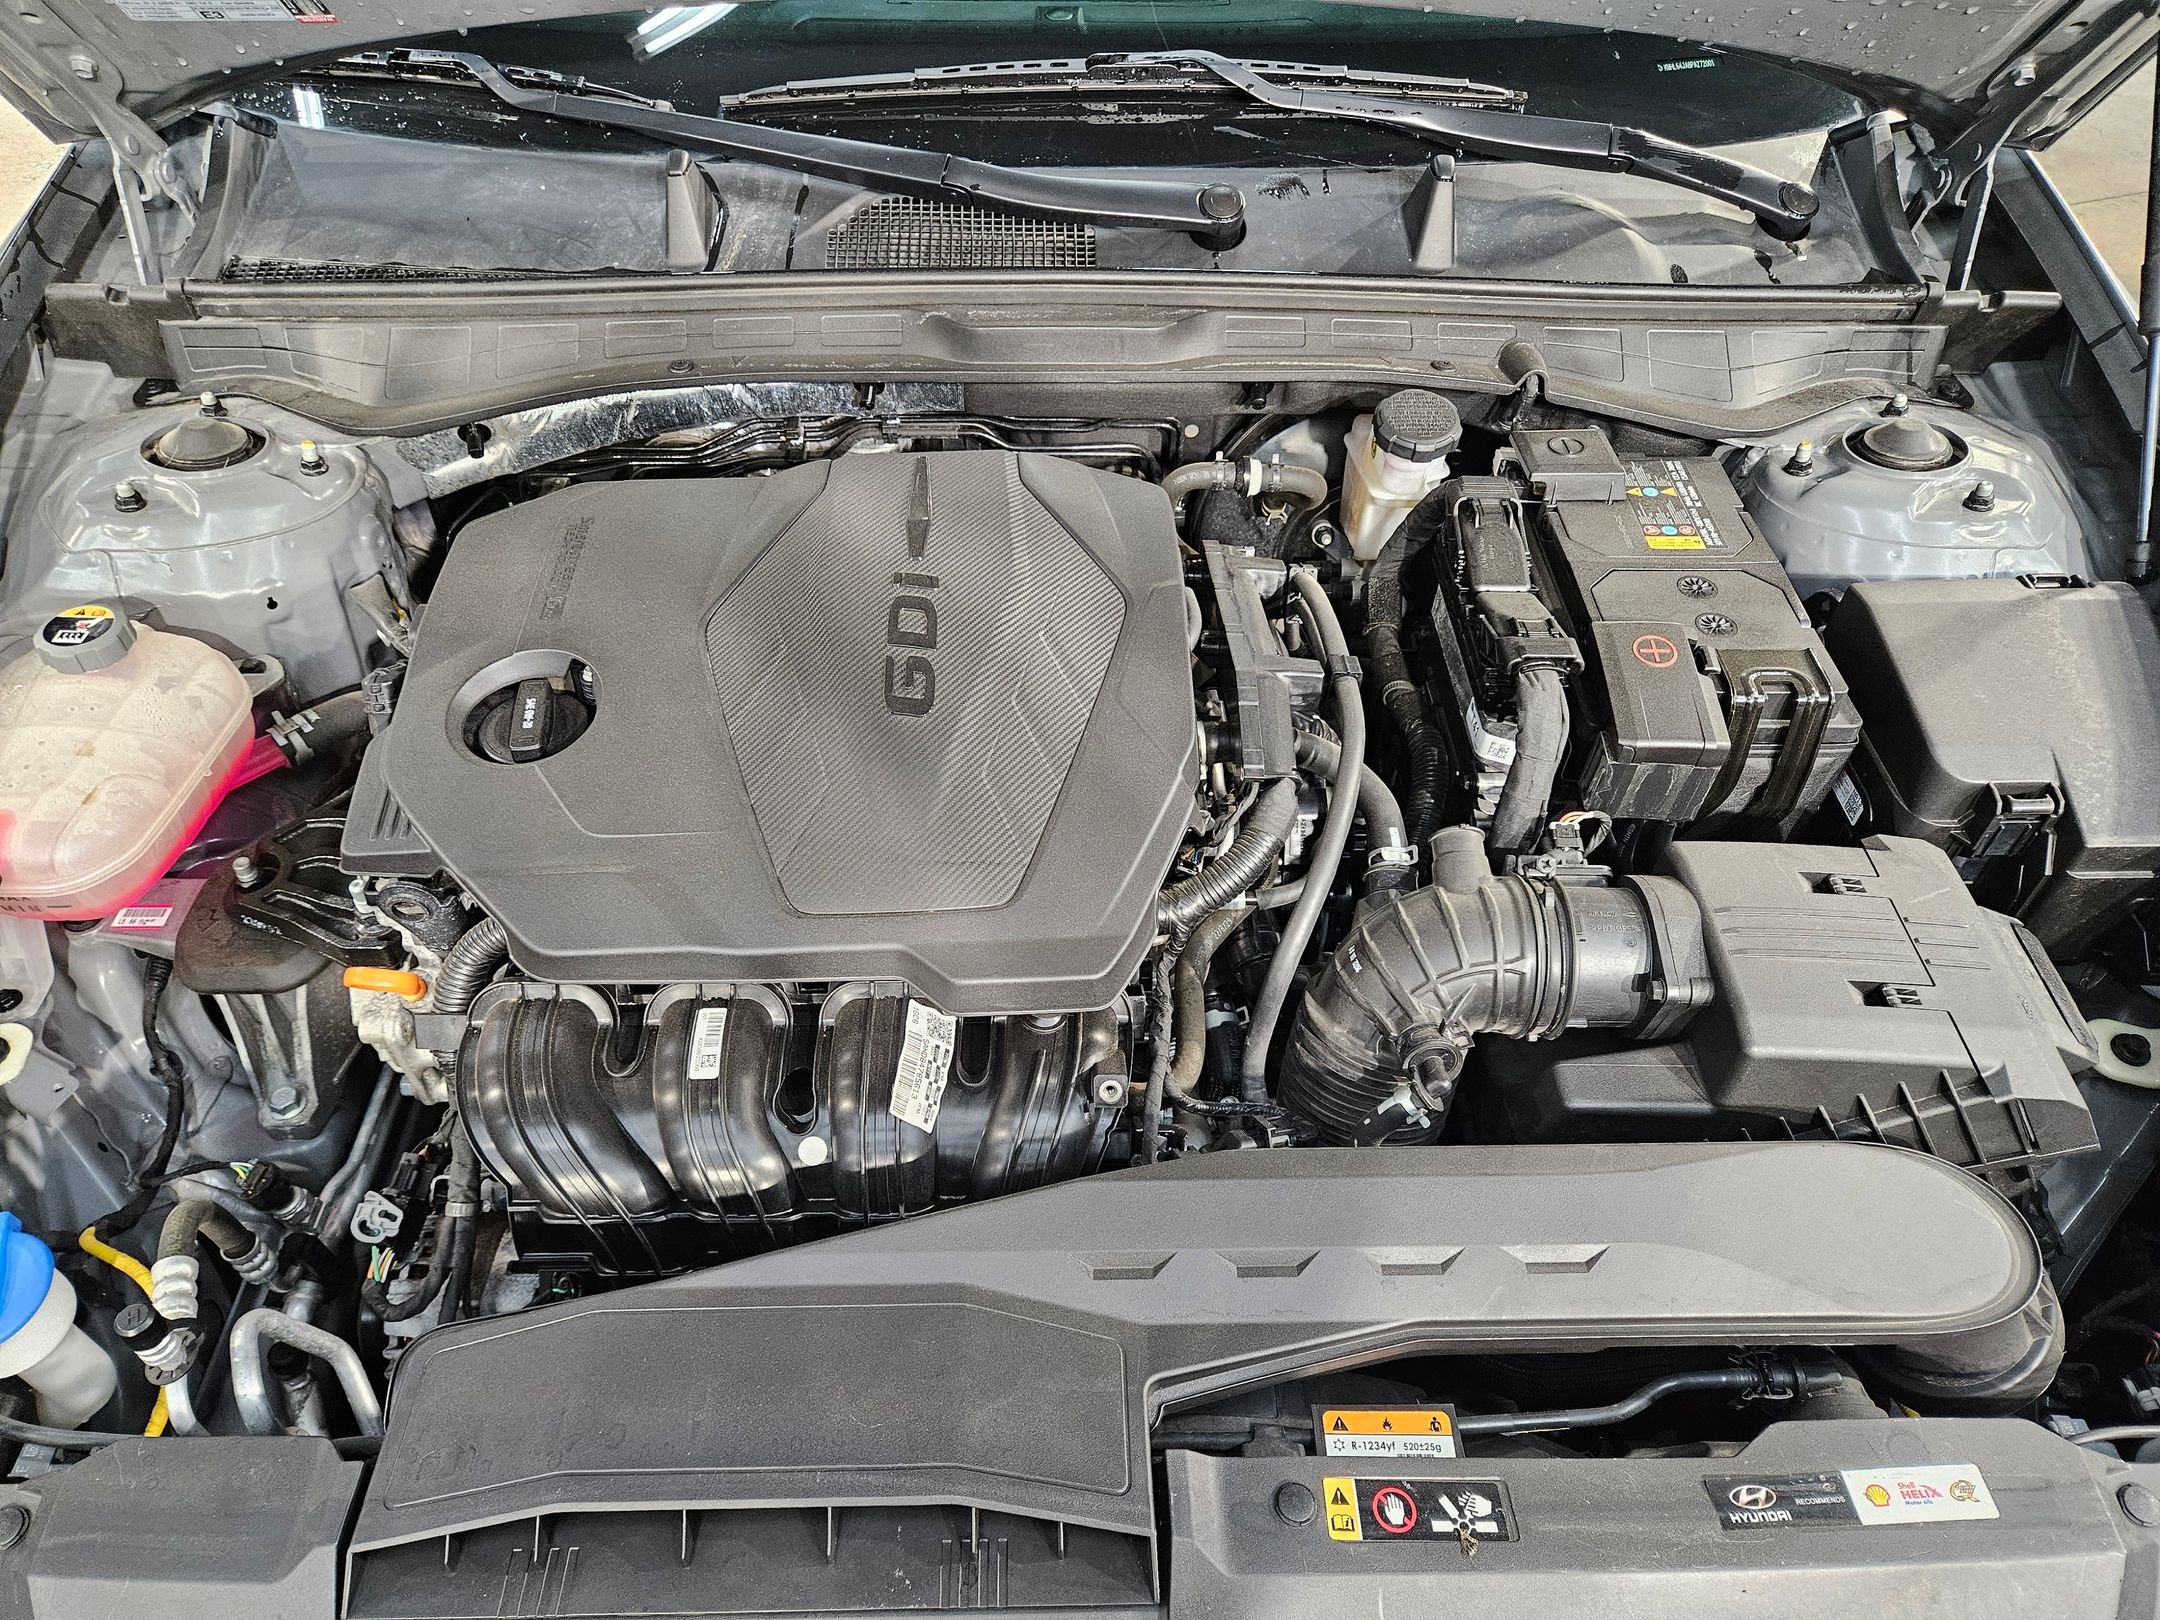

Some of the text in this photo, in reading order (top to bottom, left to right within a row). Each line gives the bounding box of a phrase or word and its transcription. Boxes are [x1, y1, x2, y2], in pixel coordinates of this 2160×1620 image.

[199, 11, 225, 19] E3
[524, 697, 537, 709] SAE
[1351, 1440, 1442, 1453] R-1234yf 520±25g
[1897, 1481, 1916, 1490] Shell
[1900, 1487, 1944, 1500] HELIX
[1794, 1495, 1846, 1506] RECOMMENDS
[1728, 1510, 1793, 1524] HYUNDAI
